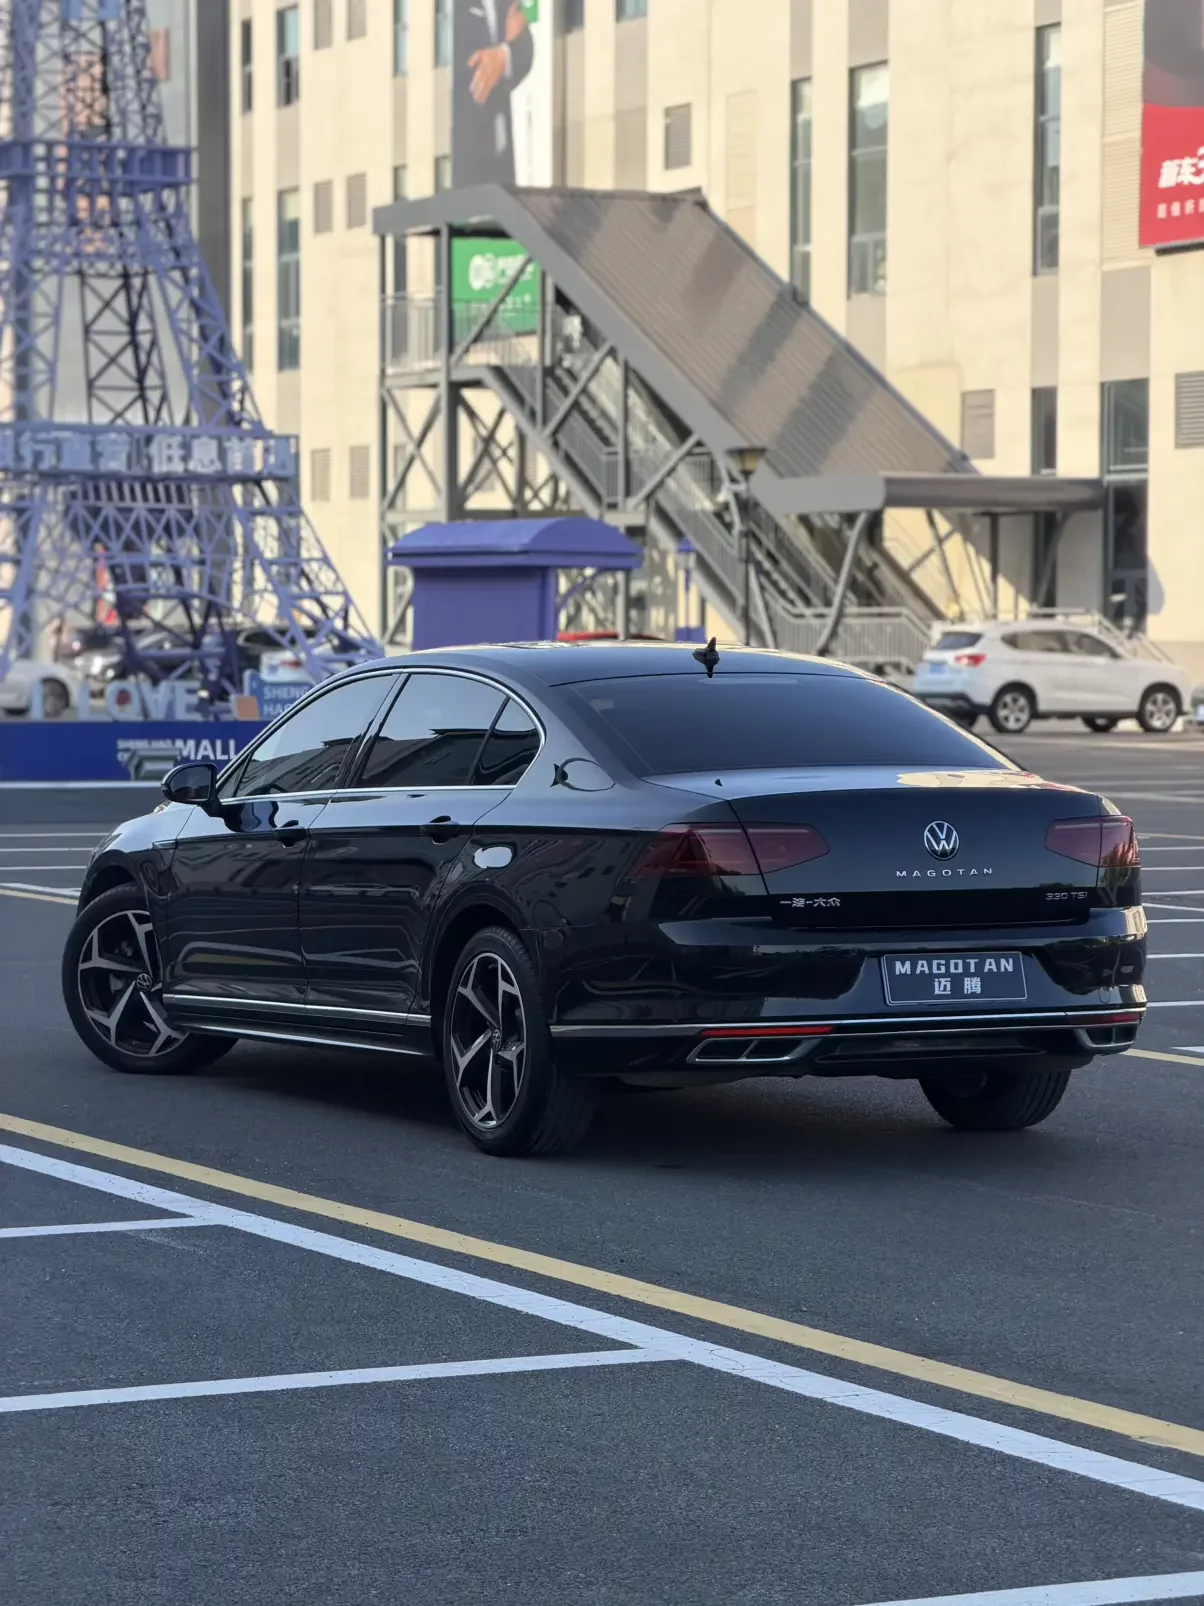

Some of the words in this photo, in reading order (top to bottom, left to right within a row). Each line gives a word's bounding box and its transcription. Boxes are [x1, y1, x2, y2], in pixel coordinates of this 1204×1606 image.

[77, 678, 204, 721] LOVE
[175, 739, 240, 760] MALL
[896, 868, 993, 878] MAGOTAN
[895, 958, 1014, 975] MAGOTAN
[934, 977, 982, 995] 迈腾
